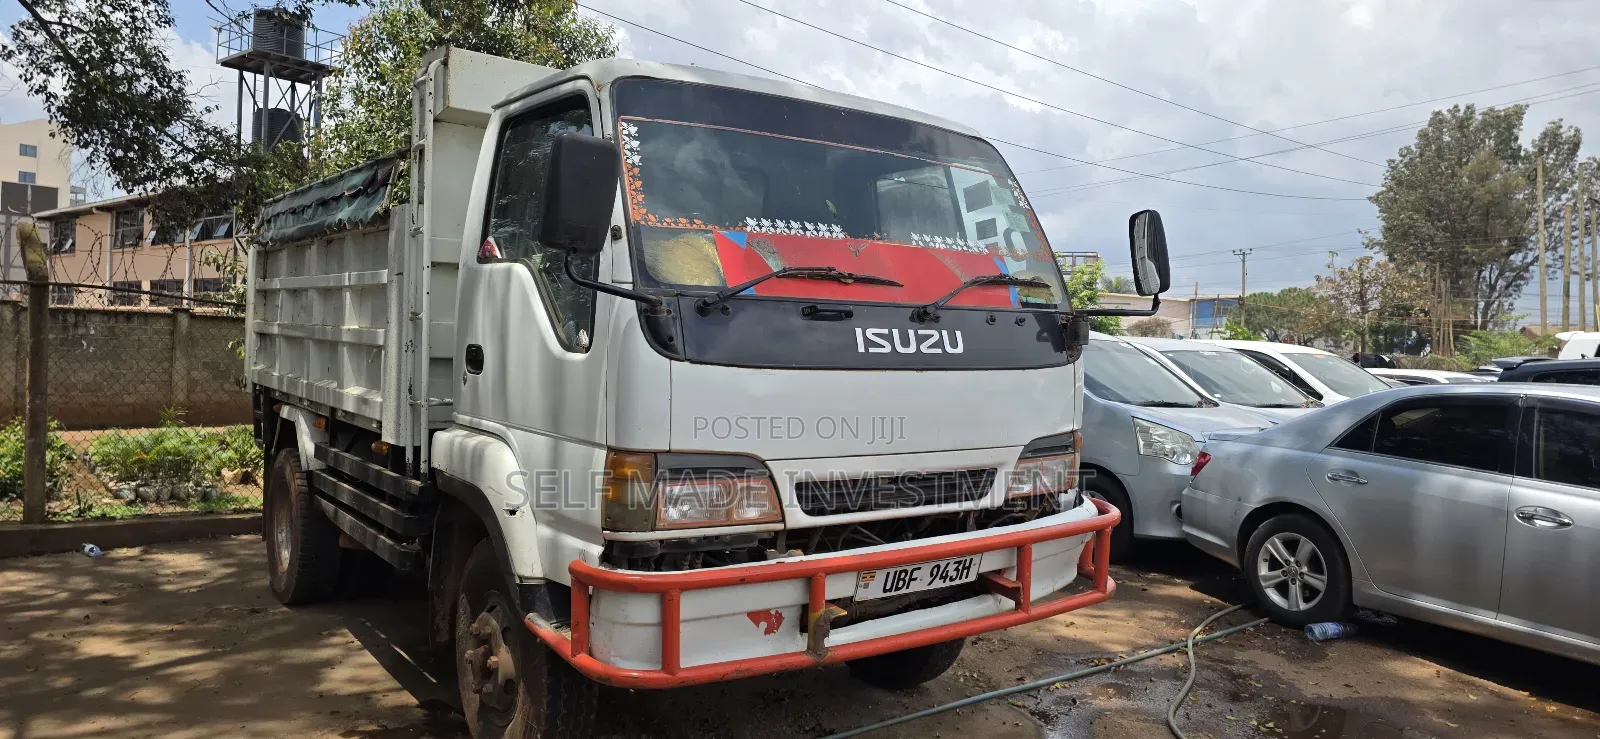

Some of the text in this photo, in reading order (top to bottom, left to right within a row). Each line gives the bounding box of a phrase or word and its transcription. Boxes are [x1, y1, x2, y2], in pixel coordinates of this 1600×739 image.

[855, 327, 964, 354] ISUZU
[882, 557, 974, 593] UBF 943H
